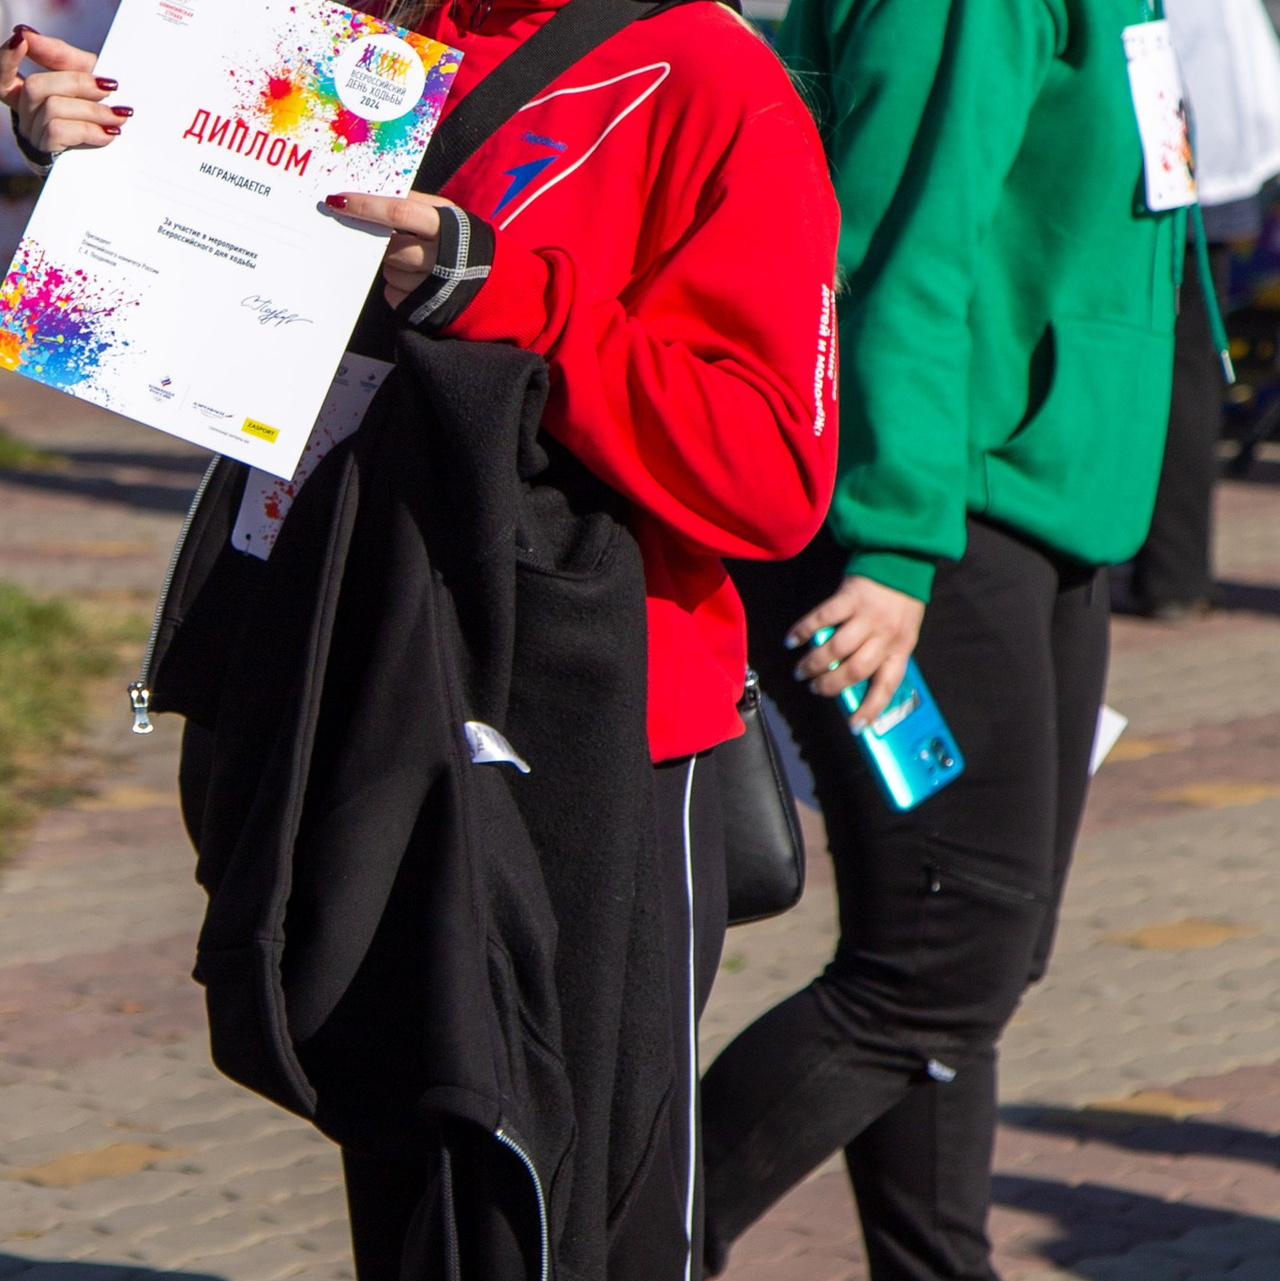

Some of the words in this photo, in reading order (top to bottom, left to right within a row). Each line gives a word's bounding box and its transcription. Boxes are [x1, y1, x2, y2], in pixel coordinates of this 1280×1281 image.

[345, 77, 368, 93] ДЕНЬ
[369, 85, 404, 106] ХОДЬБЫ
[350, 69, 407, 96] ВСЕРОССИЙСКИЙ
[360, 95, 380, 110] 2024
[183, 108, 313, 177] ДИПЛОМ
[199, 162, 272, 197] НАГРАЖДАЕТСЯ
[157, 225, 214, 254] Всероссийского
[214, 249, 228, 259] дня
[229, 254, 257, 269] ходьбы
[163, 217, 173, 226] За
[173, 222, 201, 238] участие
[208, 236, 259, 259] мероприятиях
[818, 283, 831, 337] детей
[817, 339, 827, 353] и
[246, 422, 276, 437] ZASPORT
